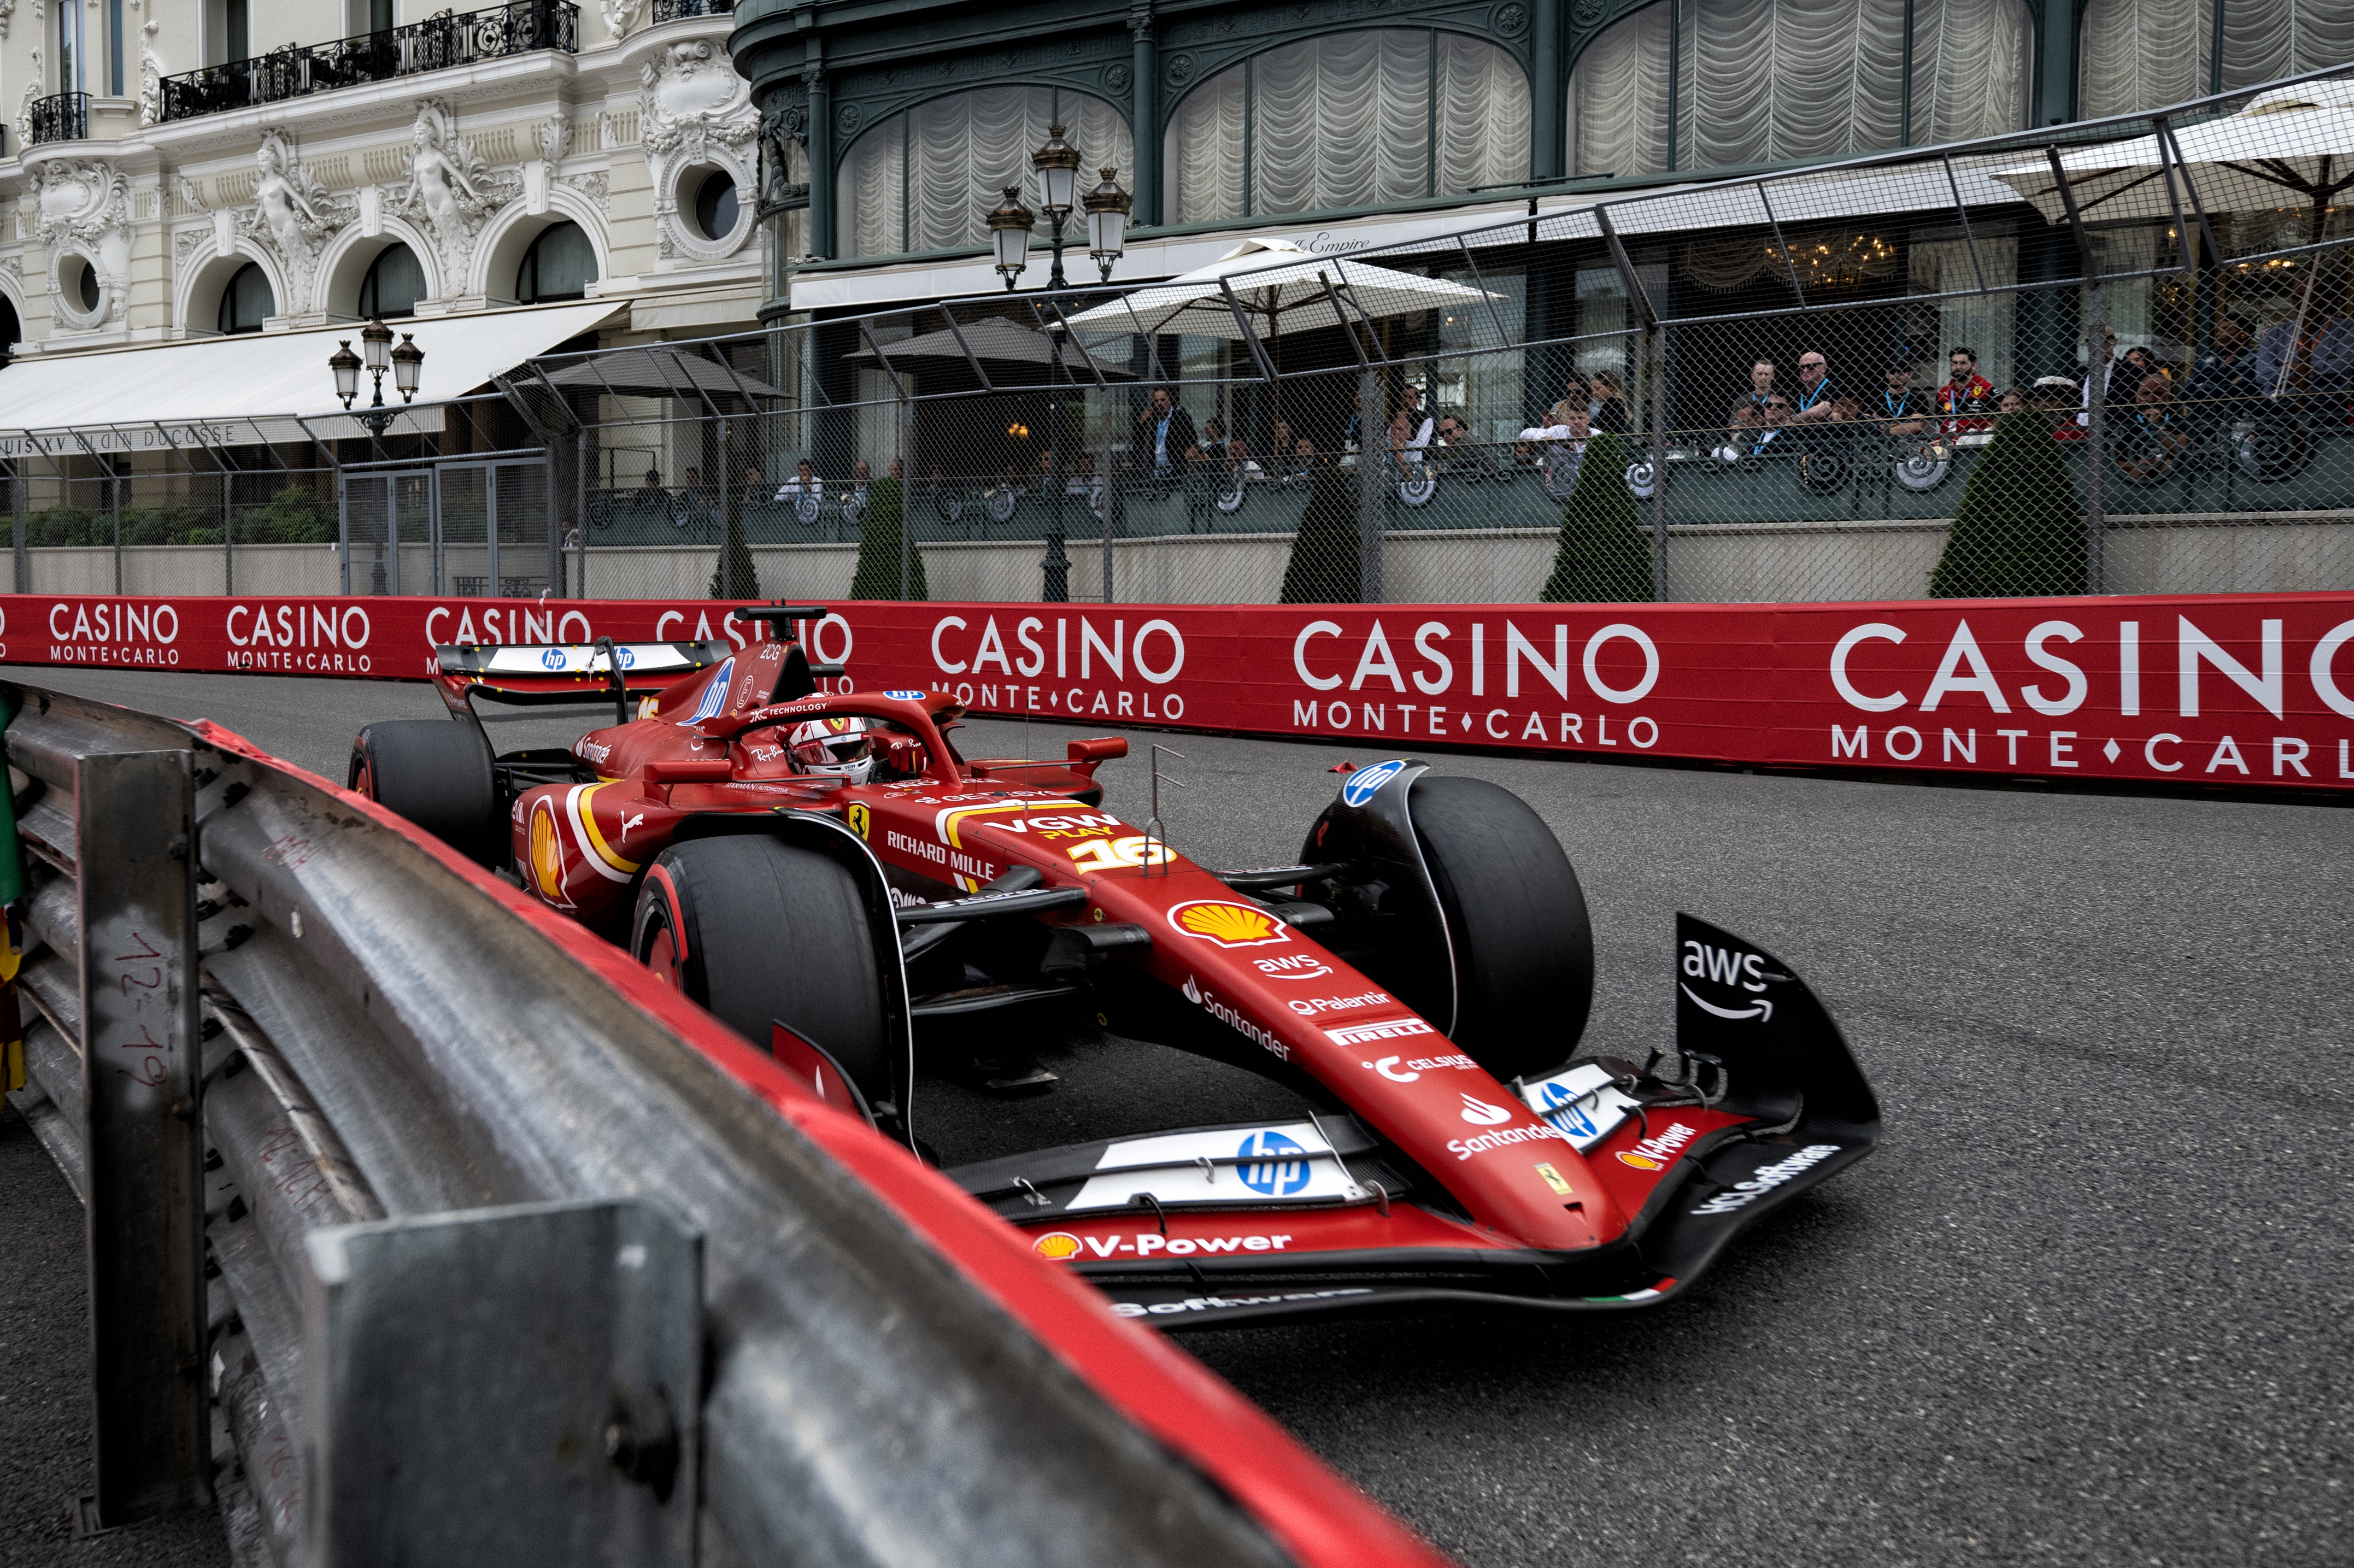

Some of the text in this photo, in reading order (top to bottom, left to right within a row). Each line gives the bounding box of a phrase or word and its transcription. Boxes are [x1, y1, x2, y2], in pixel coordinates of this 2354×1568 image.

[1310, 232, 1370, 254] Empire
[5, 439, 33, 454] UIS
[44, 437, 66, 452] XV
[49, 603, 178, 644] CASINO
[226, 604, 370, 649] CASINO
[50, 645, 179, 665] MONTE CARLO
[227, 651, 371, 672] MONTE CARLO
[545, 649, 563, 671] hp
[931, 614, 1185, 684] CASINO
[1293, 618, 1660, 704] CASINO
[770, 703, 827, 715] TECHNOLOGY
[1067, 688, 1184, 720] CARLO
[1294, 700, 1659, 749] MONTE CARLO
[1831, 724, 2354, 779] MONTE CARL
[983, 814, 1122, 833] VGW
[888, 830, 995, 882] RICHARD MILLE
[1066, 836, 1177, 876] 16
[1253, 955, 1321, 973] aws
[1682, 940, 1768, 993] aws
[1314, 991, 1391, 1013] Palantir
[1204, 990, 1290, 1062] Santander
[1323, 1018, 1435, 1047] PIRELLI
[1406, 1054, 1477, 1071] CELSIUS
[1447, 1123, 1562, 1161] Santande
[1631, 1122, 1696, 1161] V-Power
[1085, 1234, 1292, 1258] V-Power
